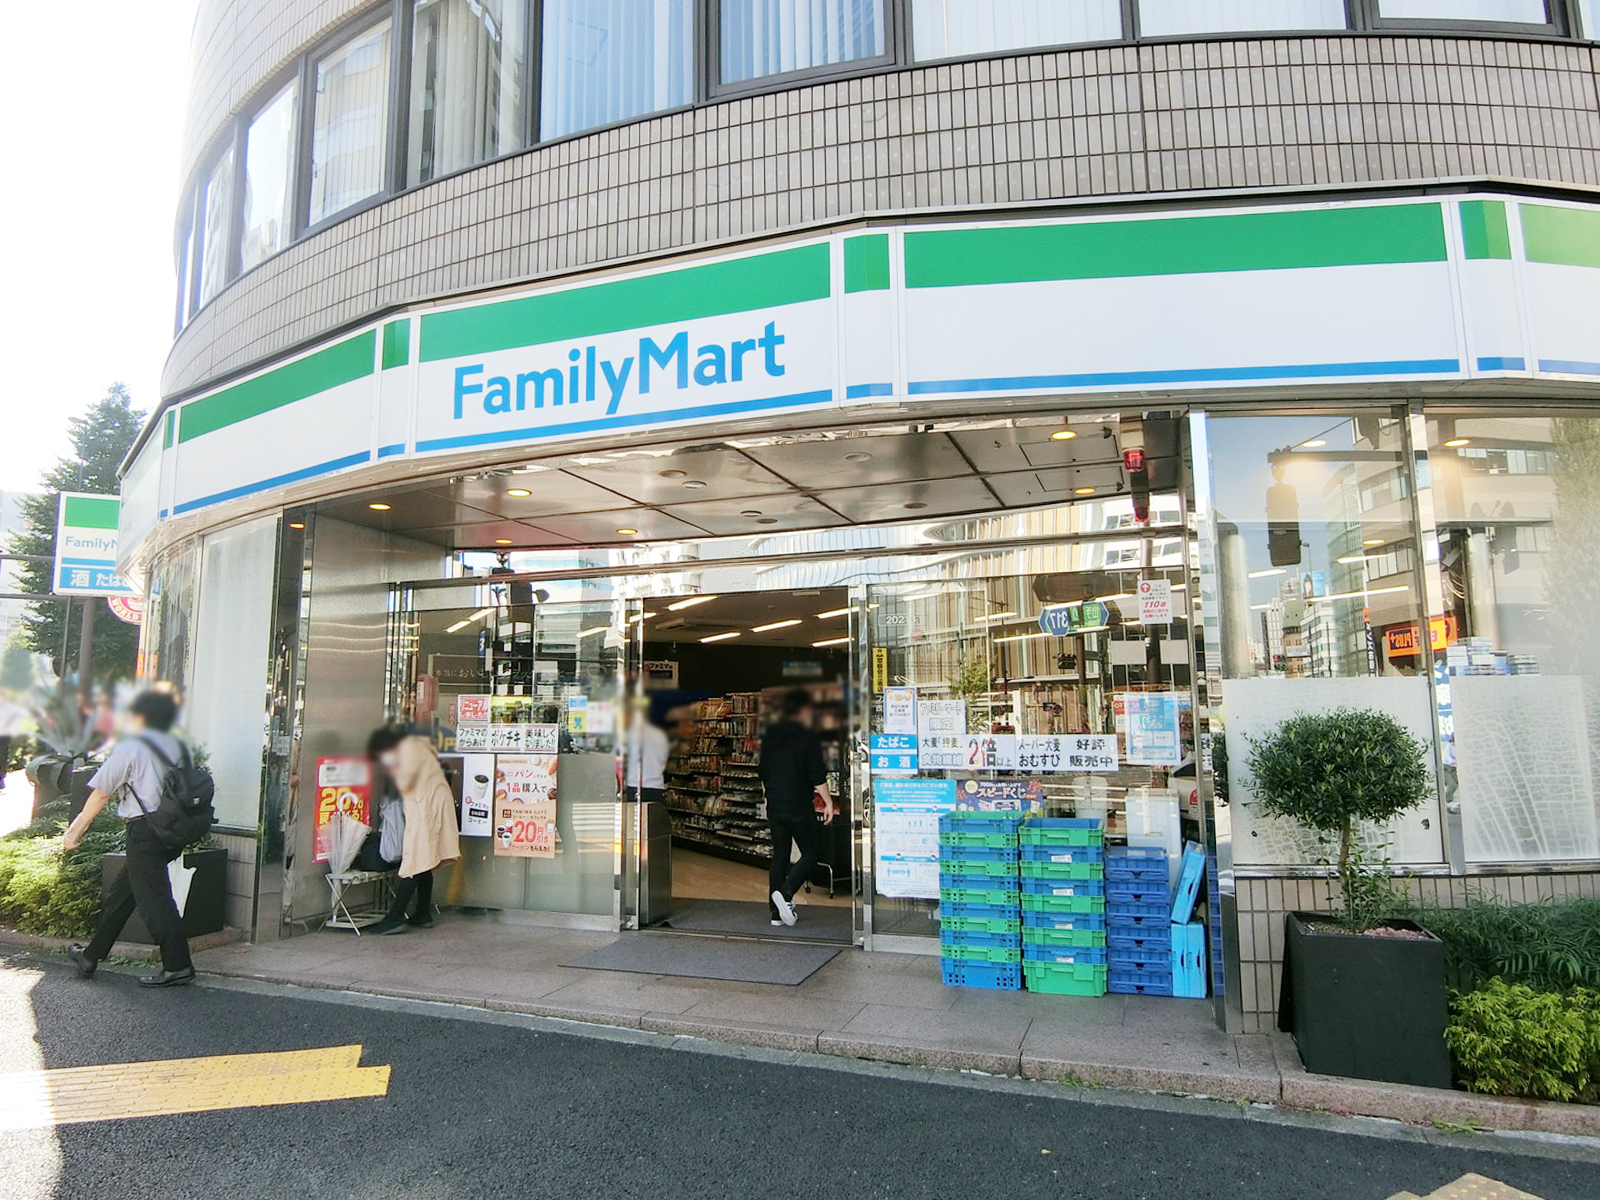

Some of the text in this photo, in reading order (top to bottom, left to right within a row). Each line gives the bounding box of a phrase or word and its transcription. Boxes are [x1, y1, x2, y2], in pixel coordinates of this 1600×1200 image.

[454, 320, 785, 420] FamilyMart
[70, 569, 91, 587] 酒
[459, 728, 488, 737] ファミマの
[525, 728, 556, 738] 美味しく
[460, 738, 487, 747] からあげ
[877, 736, 910, 748] たばこ
[1076, 738, 1105, 751] 好評
[1019, 753, 1061, 768] おむすび
[1069, 755, 1113, 768] 販売中
[506, 782, 547, 793] 1品購入で
[976, 787, 1027, 799] スピードくじ
